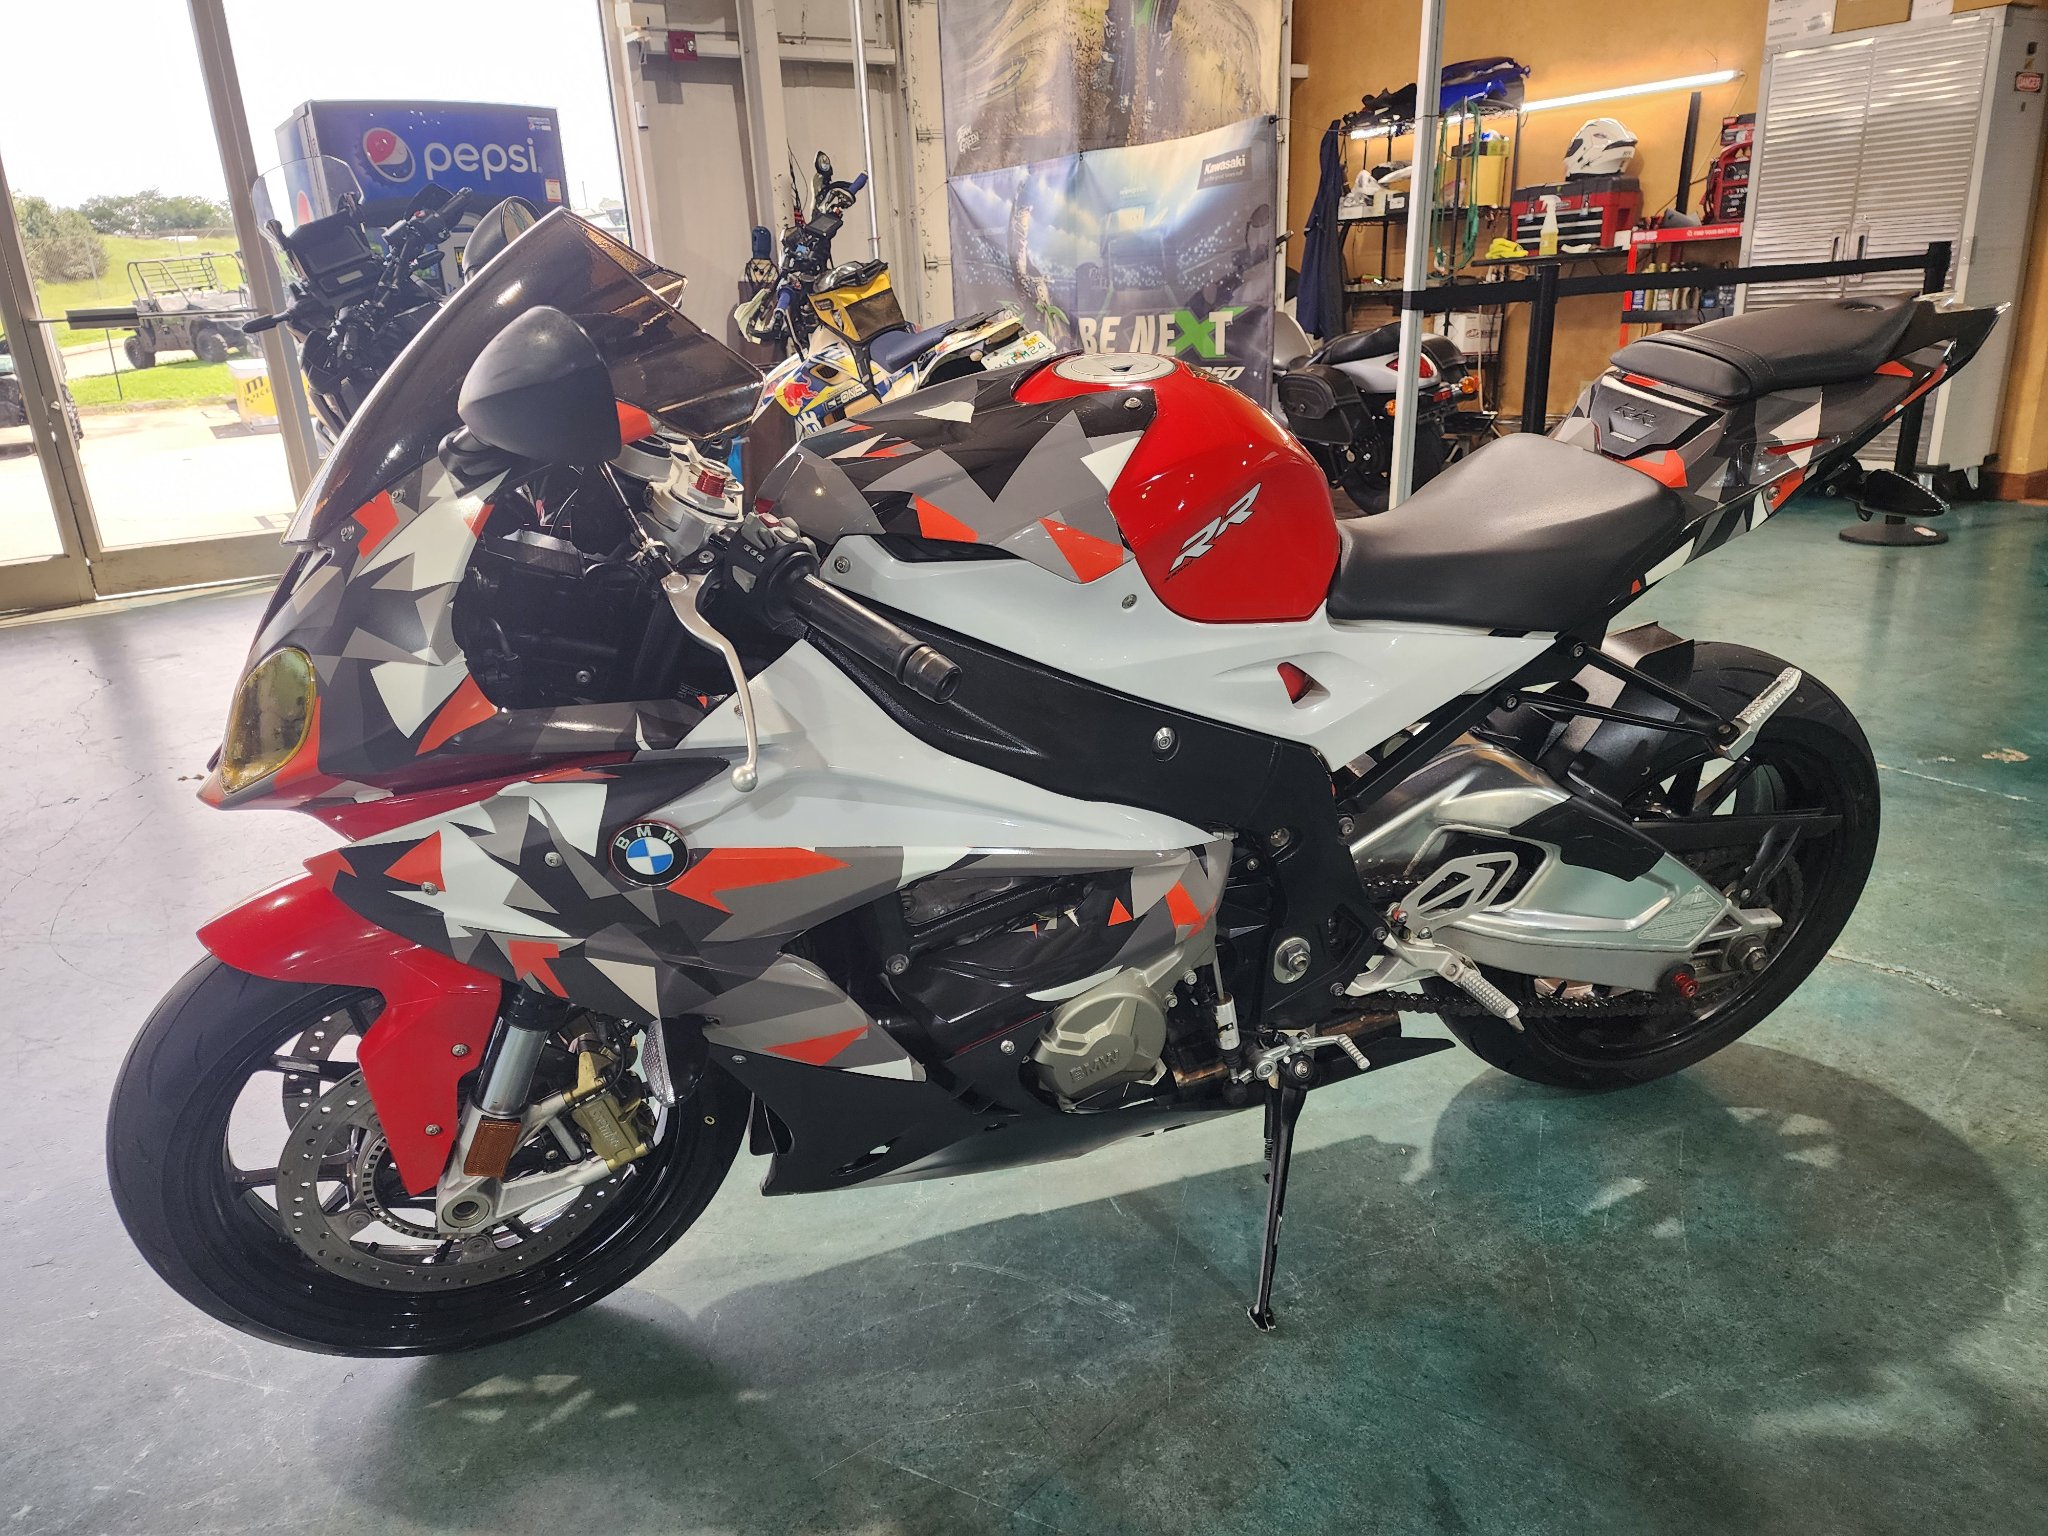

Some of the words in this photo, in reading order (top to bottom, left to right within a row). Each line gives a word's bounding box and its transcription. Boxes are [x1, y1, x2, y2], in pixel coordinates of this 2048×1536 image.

[423, 137, 538, 181] pepsi
[1204, 154, 1246, 176] Kawasaki
[1078, 316, 1122, 355] BE
[1129, 305, 1249, 360] NEXT
[1169, 482, 1262, 574] RR
[615, 825, 679, 850] BMW
[1069, 1048, 1119, 1081] BMW
